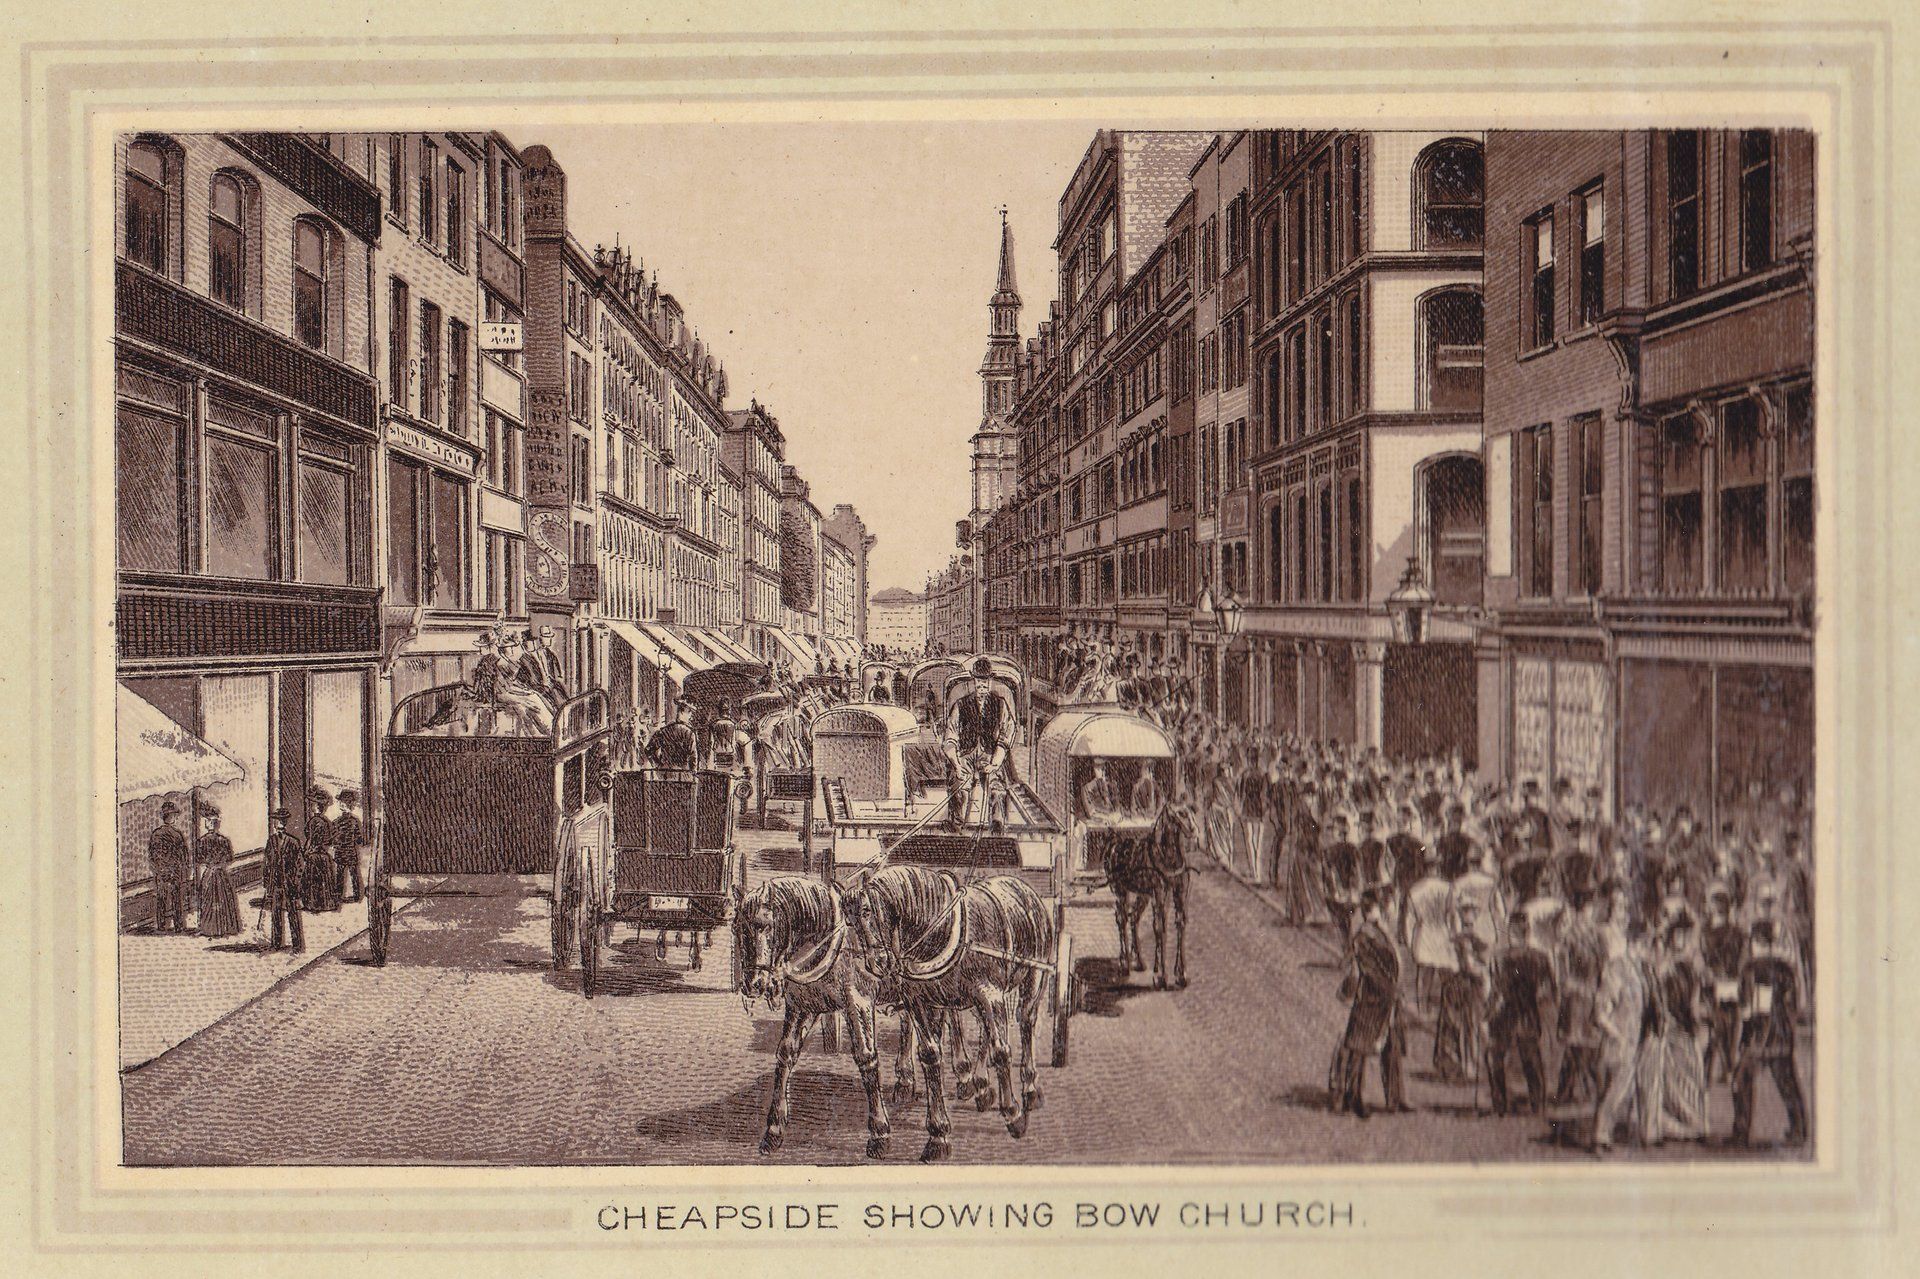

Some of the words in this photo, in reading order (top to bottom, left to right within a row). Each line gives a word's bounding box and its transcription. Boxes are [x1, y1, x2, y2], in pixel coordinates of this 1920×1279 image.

[597, 1203, 839, 1231] CHEAPSIDE
[862, 1202, 1054, 1230] SHOWING
[1075, 1201, 1161, 1229] BOW
